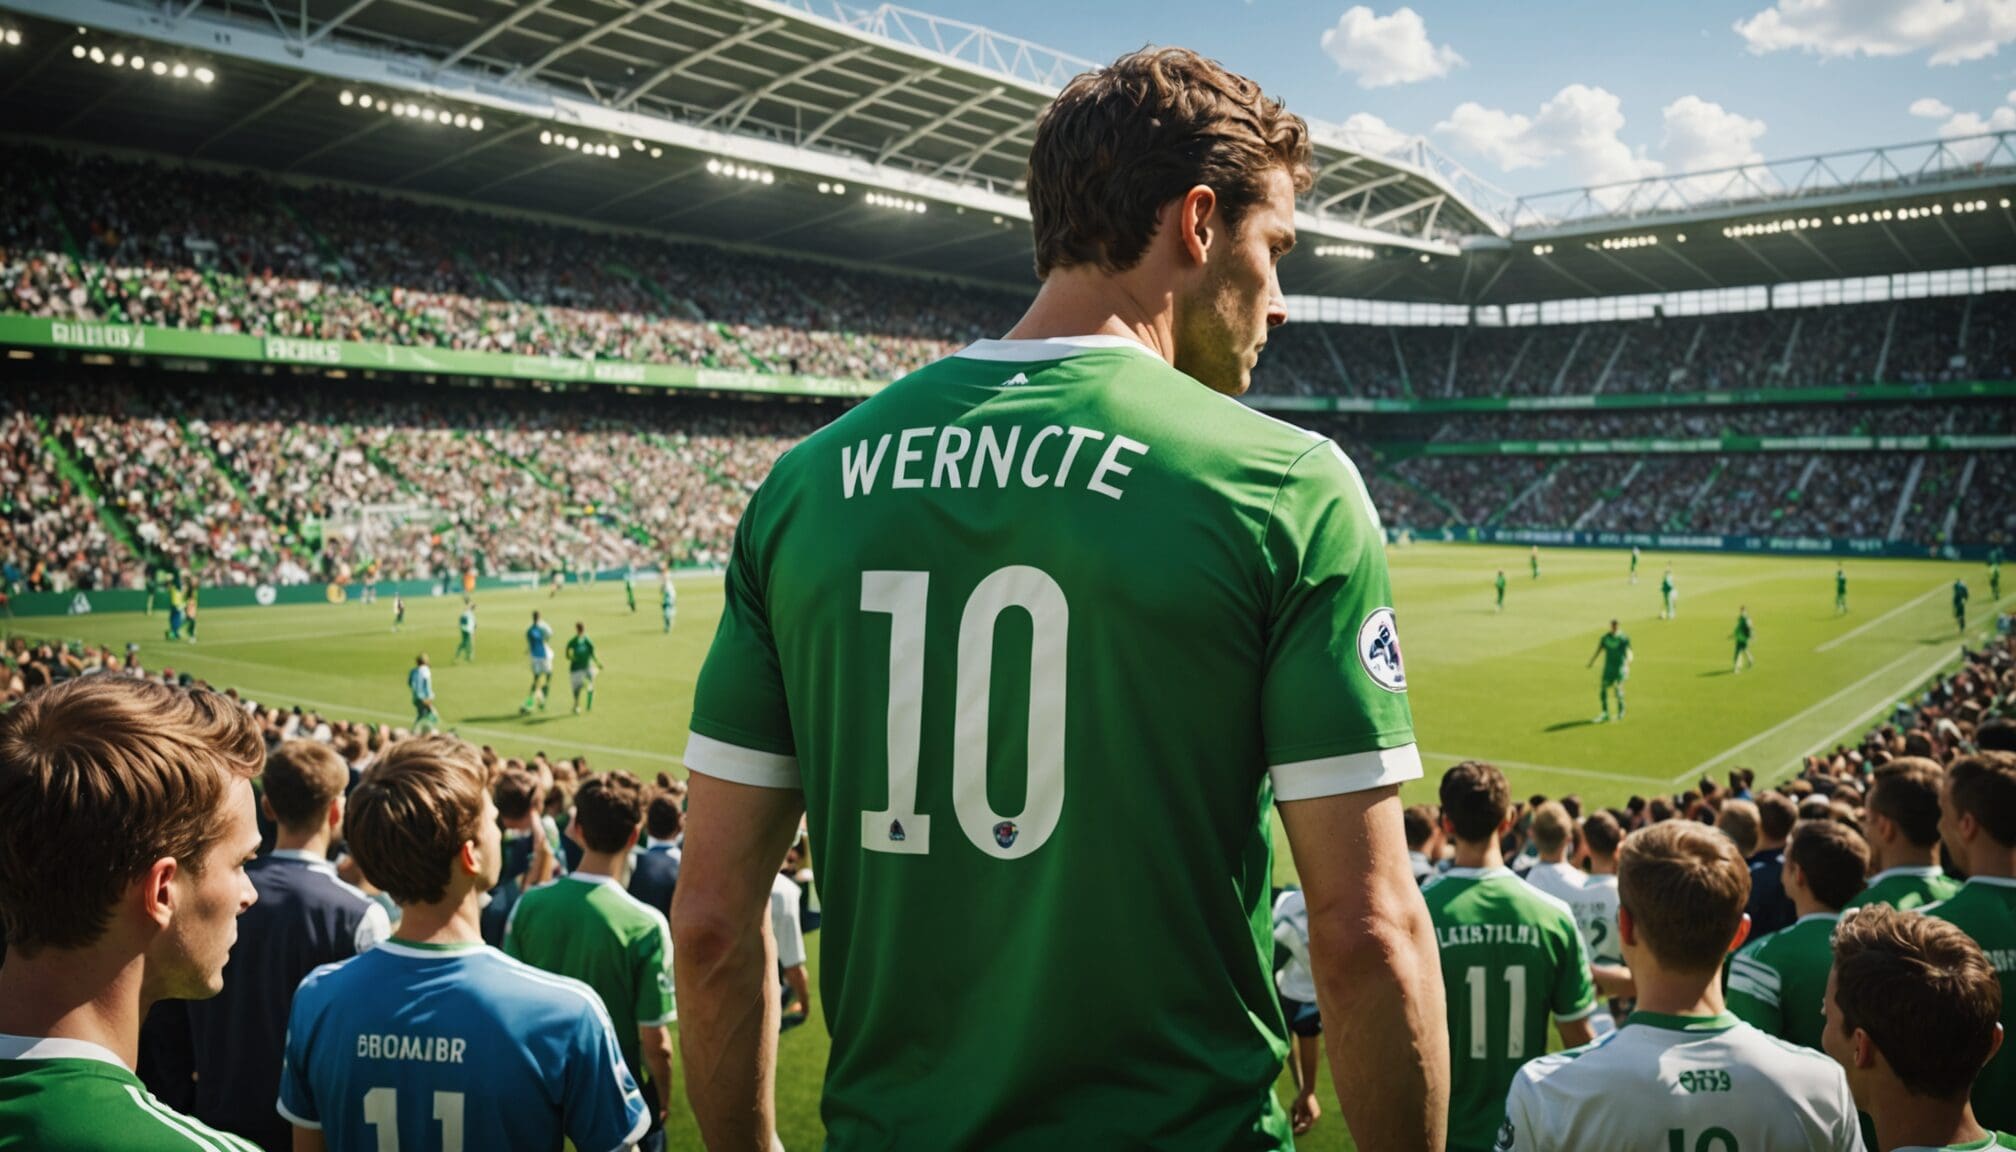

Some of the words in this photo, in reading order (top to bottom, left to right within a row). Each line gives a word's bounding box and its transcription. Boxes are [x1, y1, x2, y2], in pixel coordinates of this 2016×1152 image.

[841, 425, 1150, 500] WERNCTE
[860, 565, 1069, 860] 10
[1465, 965, 1526, 1059] 11
